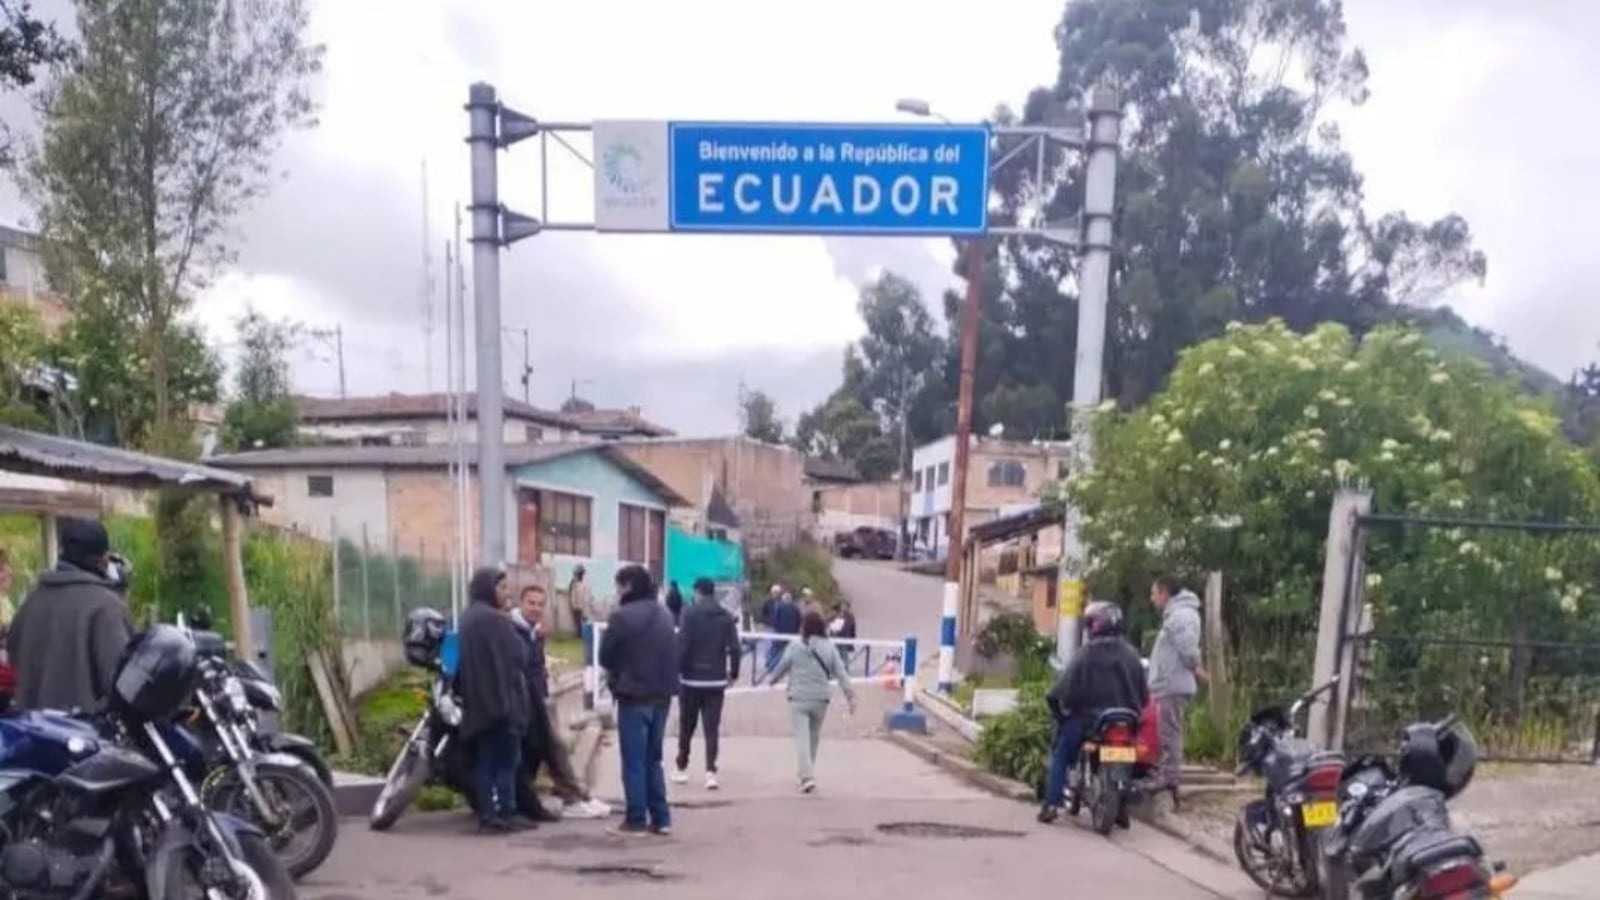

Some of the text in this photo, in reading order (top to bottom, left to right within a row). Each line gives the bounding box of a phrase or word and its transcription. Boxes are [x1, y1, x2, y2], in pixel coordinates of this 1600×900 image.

[699, 140, 960, 166] Bienvenido a la República del
[698, 173, 960, 216] ECUADOR
